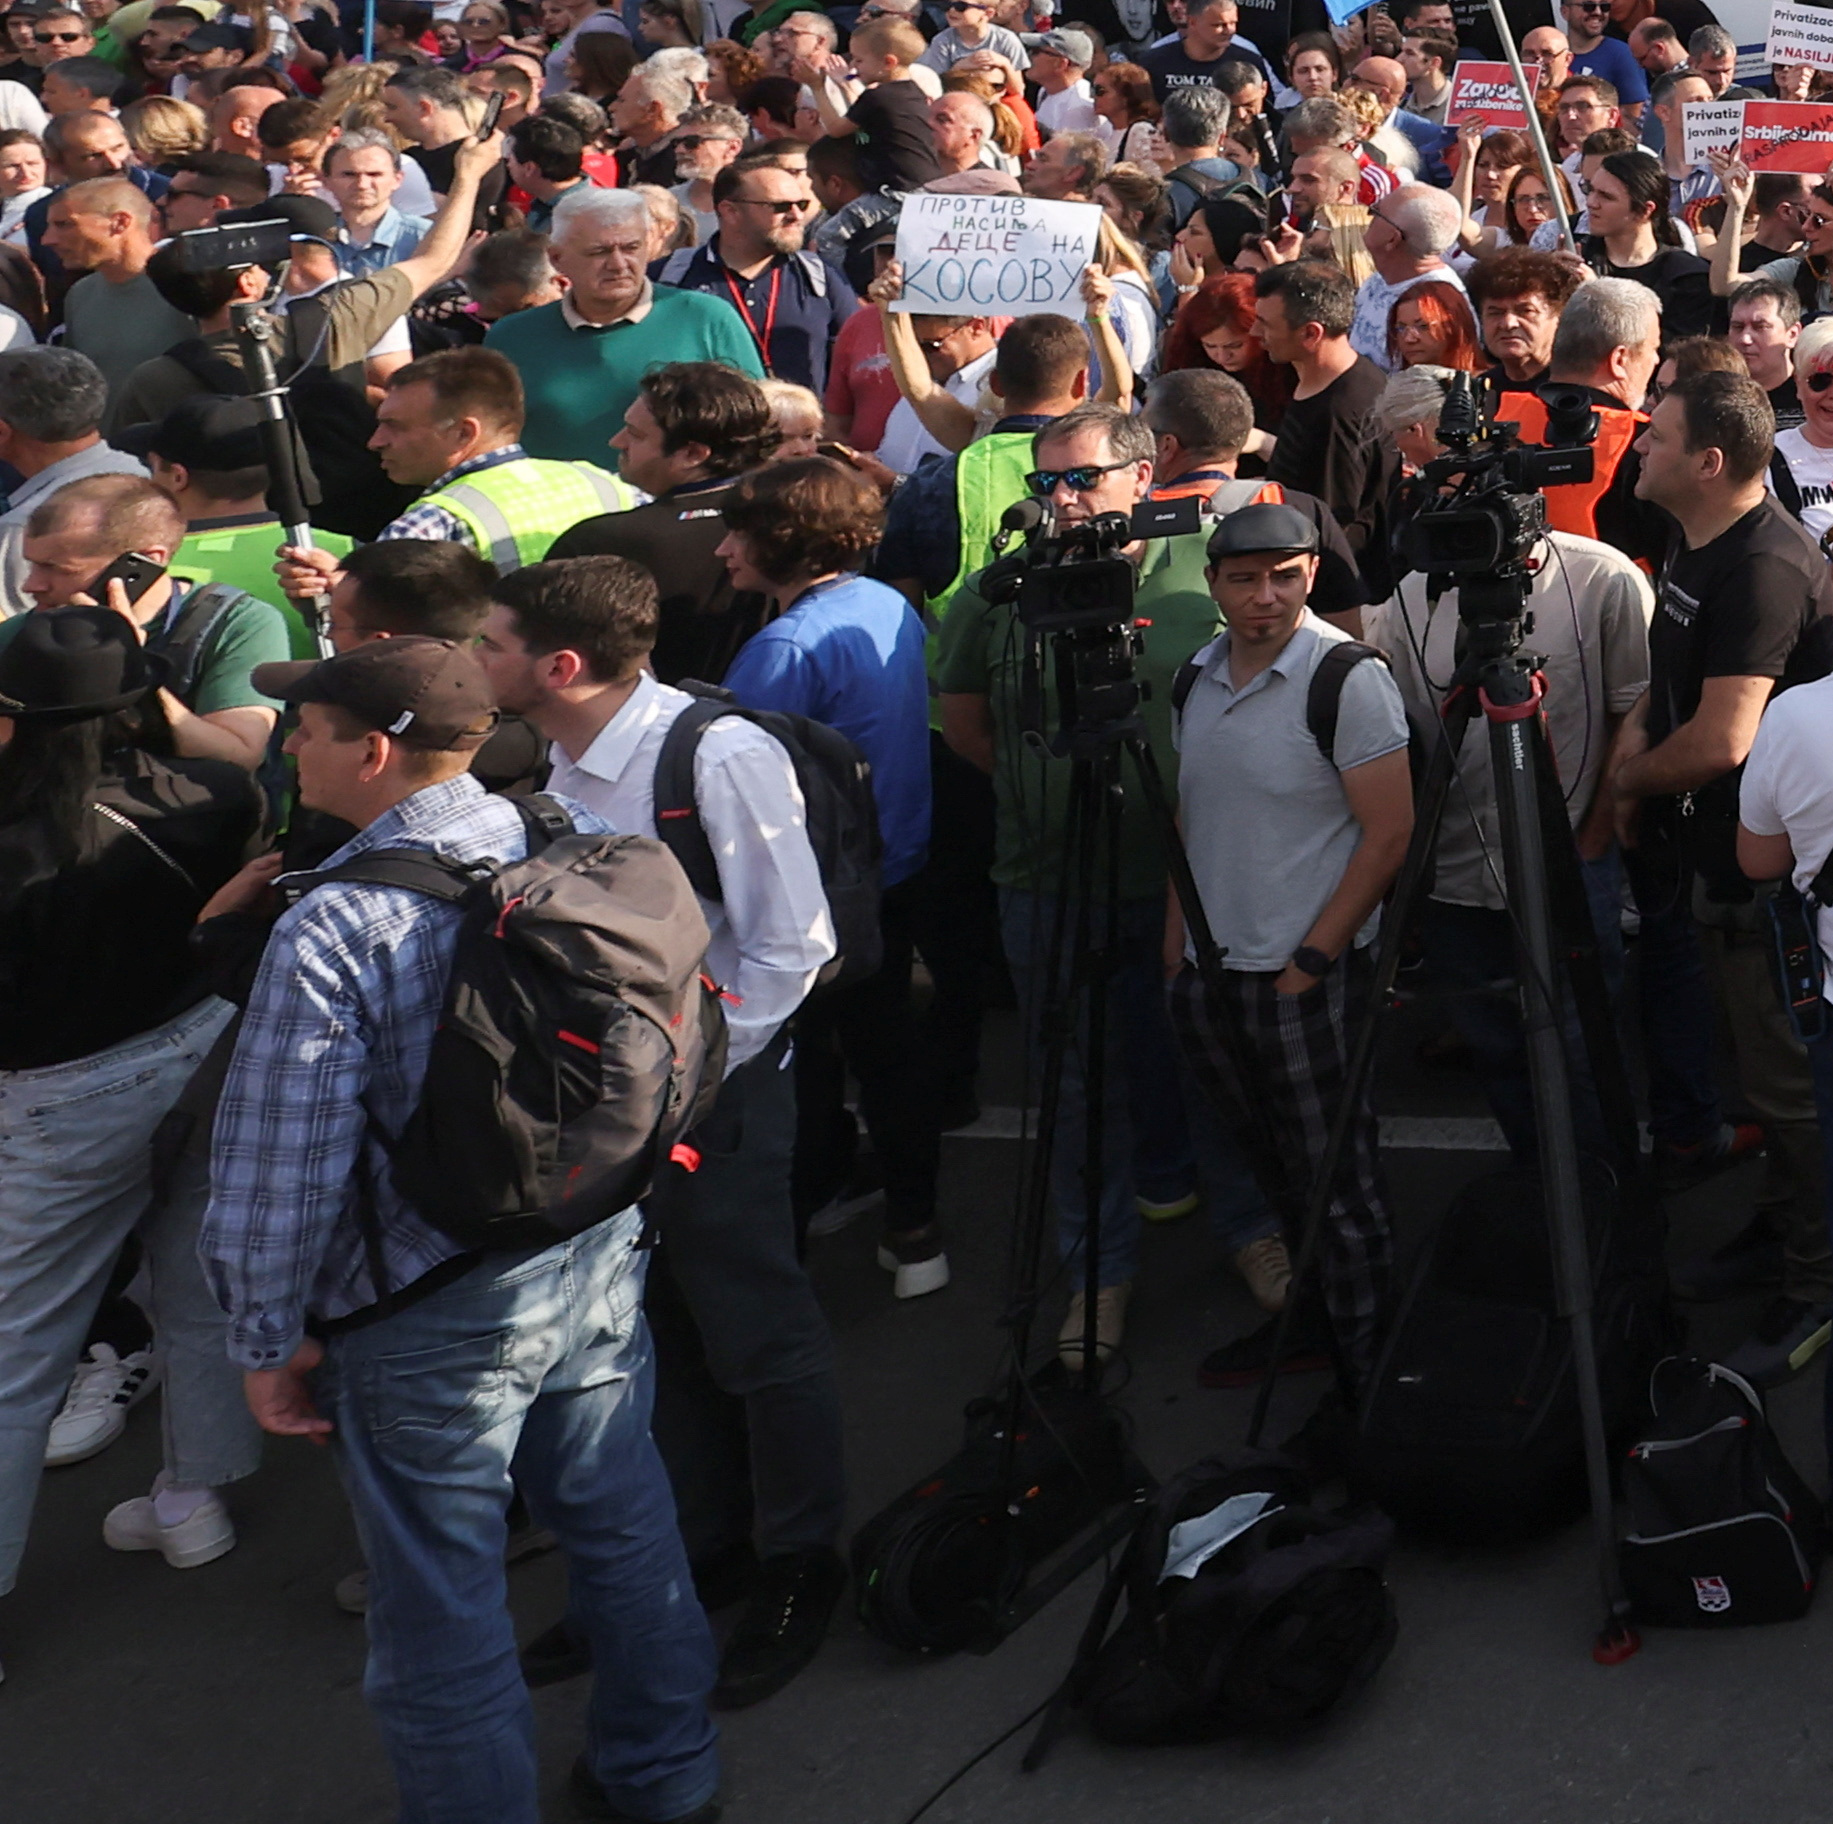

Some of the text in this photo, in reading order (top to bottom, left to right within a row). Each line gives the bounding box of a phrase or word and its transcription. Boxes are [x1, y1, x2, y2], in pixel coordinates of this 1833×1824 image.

[1770, 25, 1804, 39] javnih
[1772, 44, 1783, 57] je
[1165, 75, 1194, 88] TOM
[1688, 126, 1727, 140] javnih
[920, 196, 1026, 216] ПРОТИВ
[953, 216, 1047, 232] НАСИЉА
[928, 231, 1085, 255] ДЕЦЕ НА
[901, 257, 1089, 305] КОСОВУ
[1510, 723, 1525, 771] sachtler
